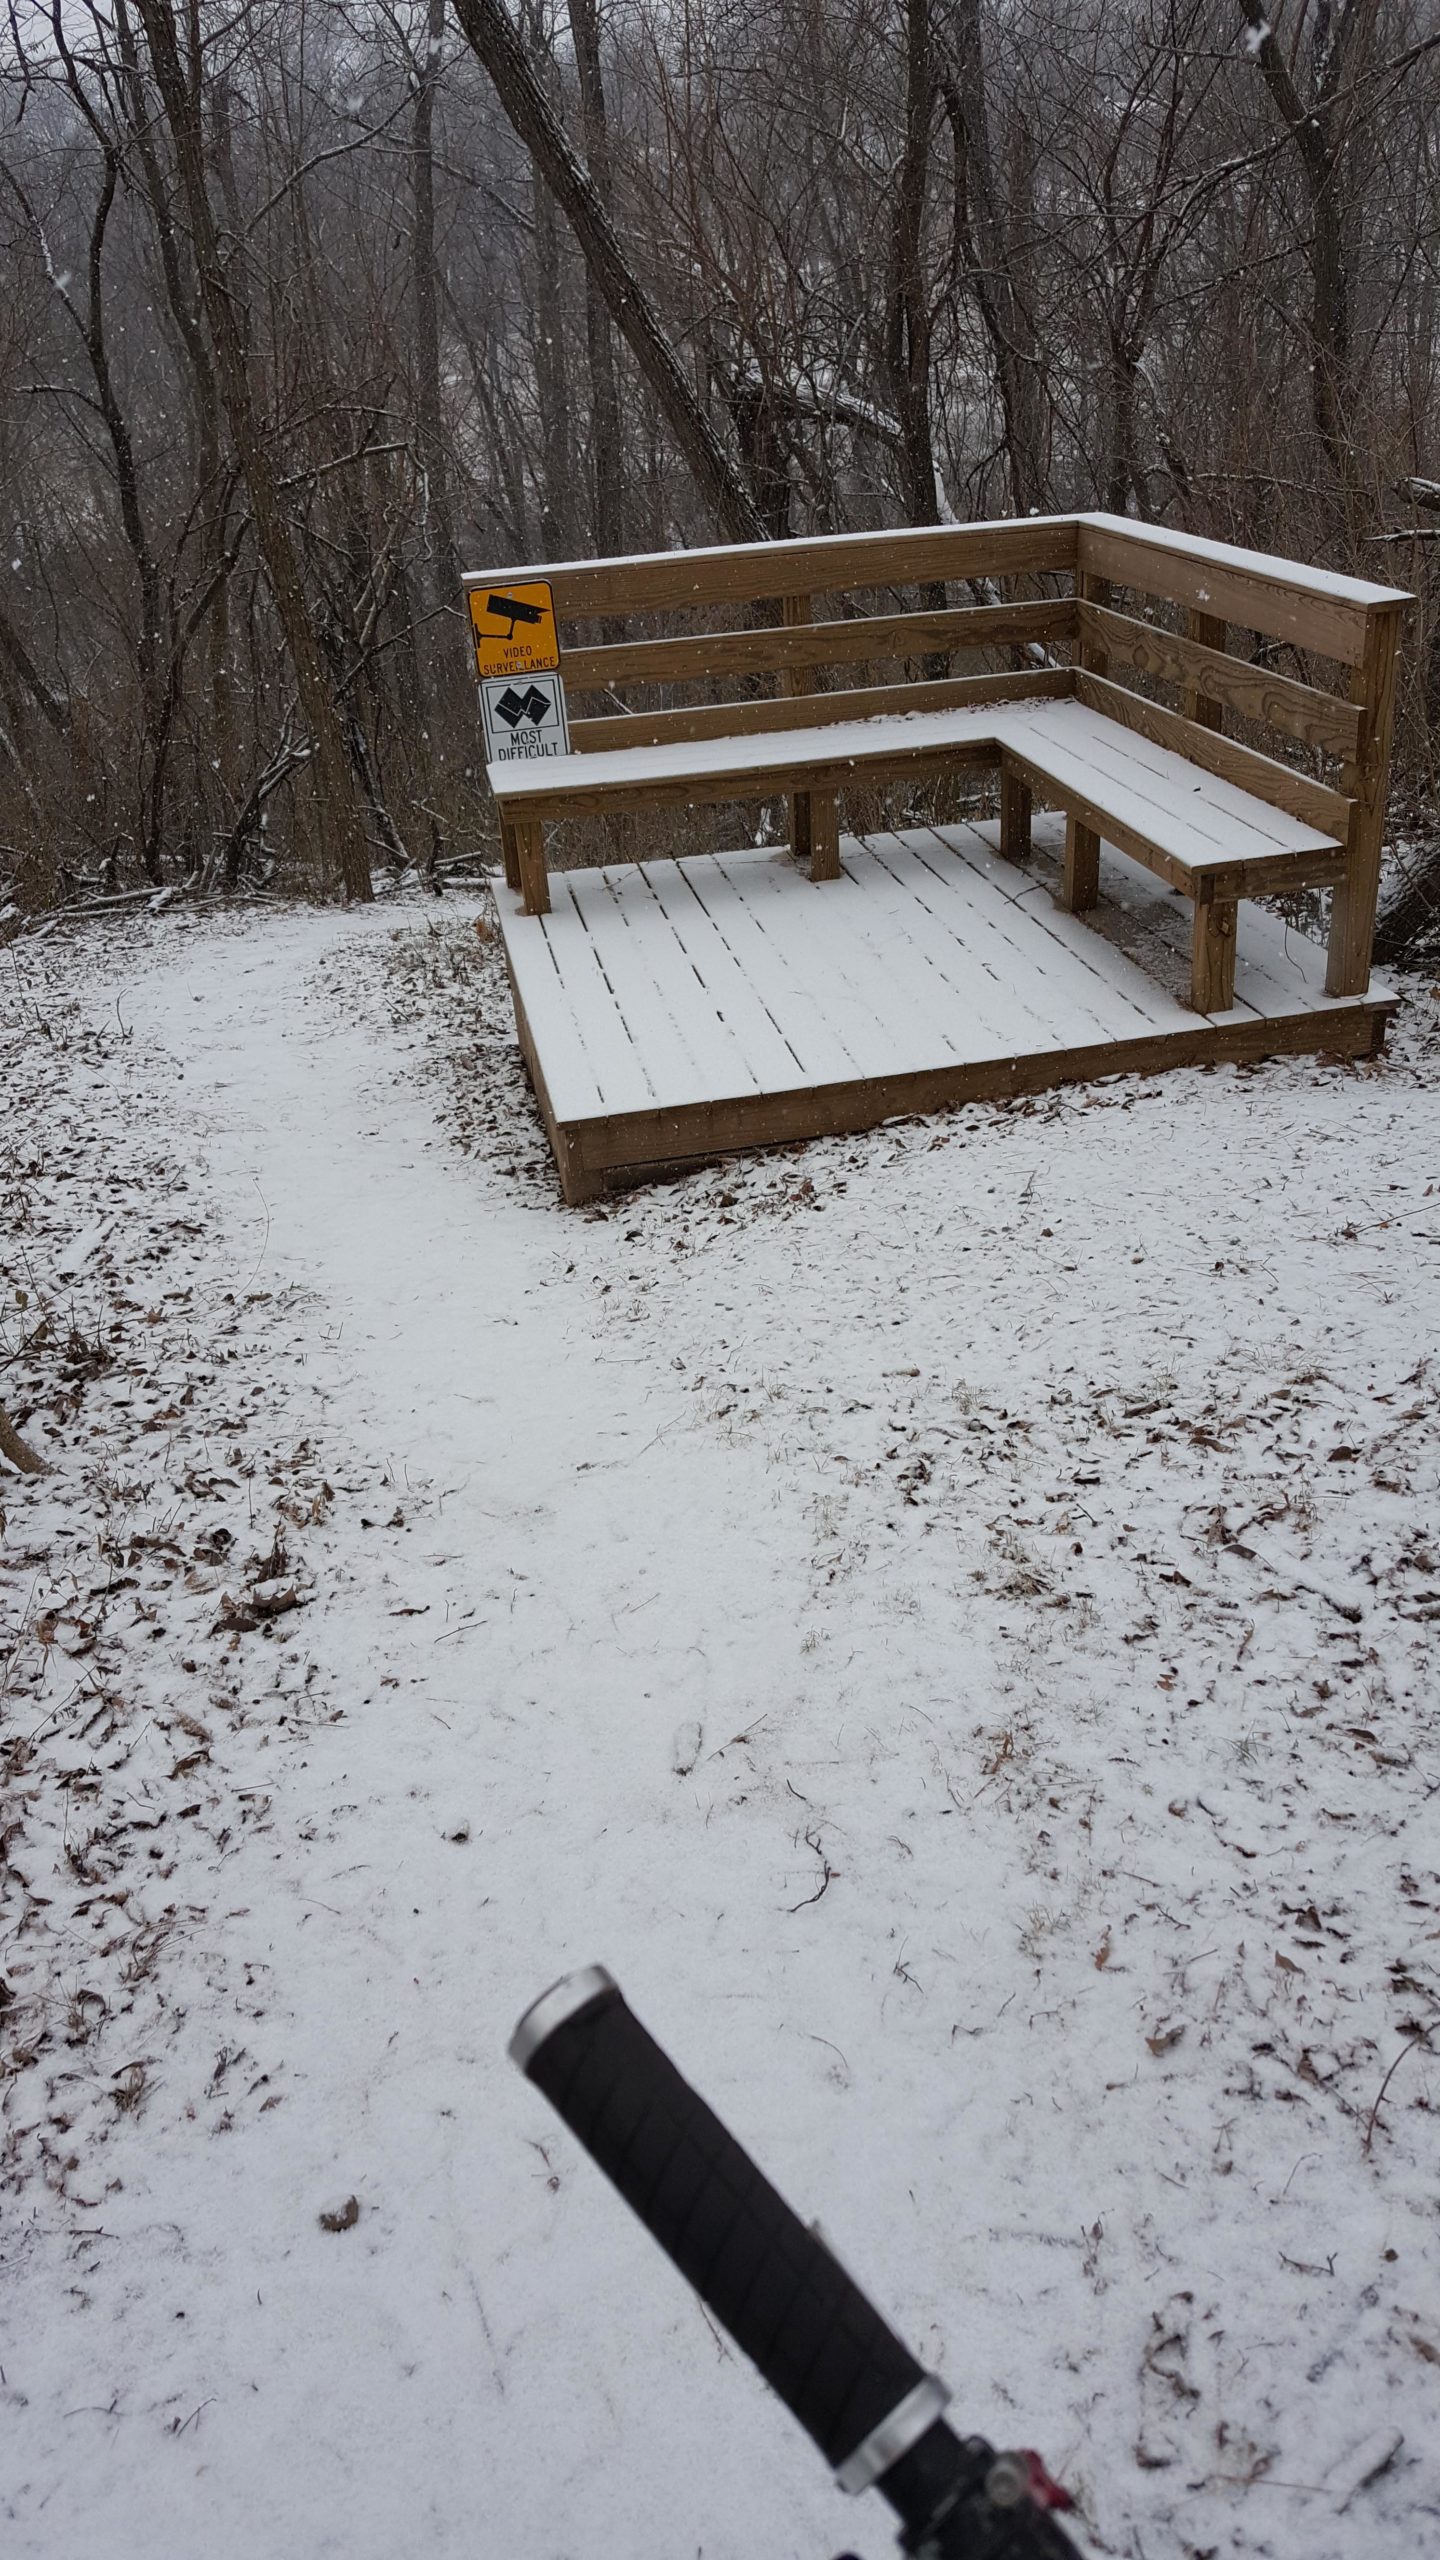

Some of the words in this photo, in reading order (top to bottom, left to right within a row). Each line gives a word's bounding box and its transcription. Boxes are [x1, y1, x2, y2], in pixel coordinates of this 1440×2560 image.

[503, 645, 532, 659] VIDEO
[510, 730, 542, 747] MOST
[498, 742, 558, 761] DIFFICULT
